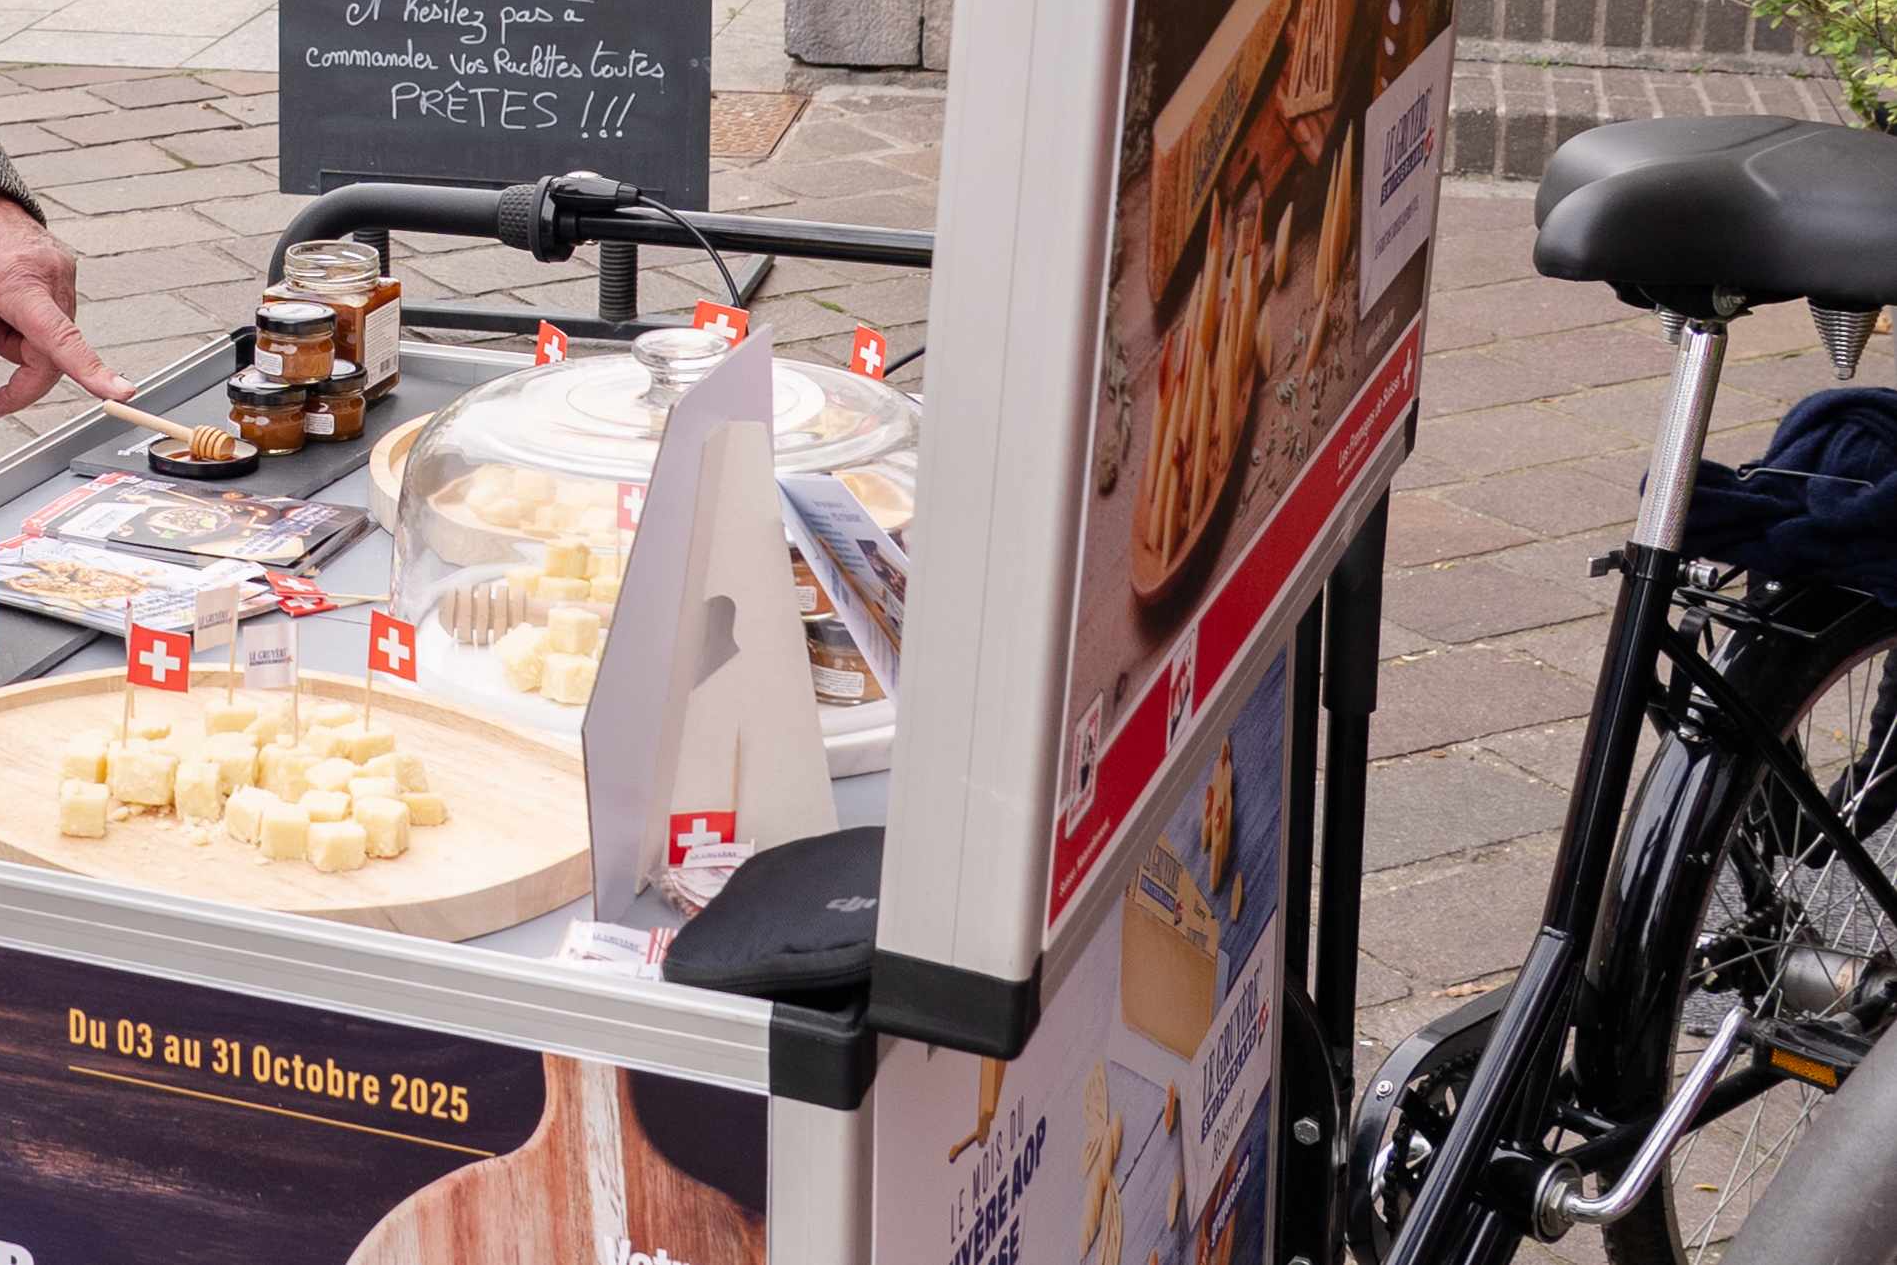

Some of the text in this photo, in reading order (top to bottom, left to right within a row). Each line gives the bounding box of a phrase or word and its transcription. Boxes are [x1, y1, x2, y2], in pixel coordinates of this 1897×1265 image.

[494, 44, 583, 79] Raclettes
[589, 40, 665, 79] toutes
[500, 6, 554, 44] pas
[390, 81, 558, 129] PRÊTES
[69, 1008, 469, 1123] Du 03 au 31 Octobre 2025
[1202, 964, 1260, 1114] LE GRUYÈRE
[951, 1095, 1024, 1245] LE MOIS DU
[1011, 1115, 1046, 1210] AOP
